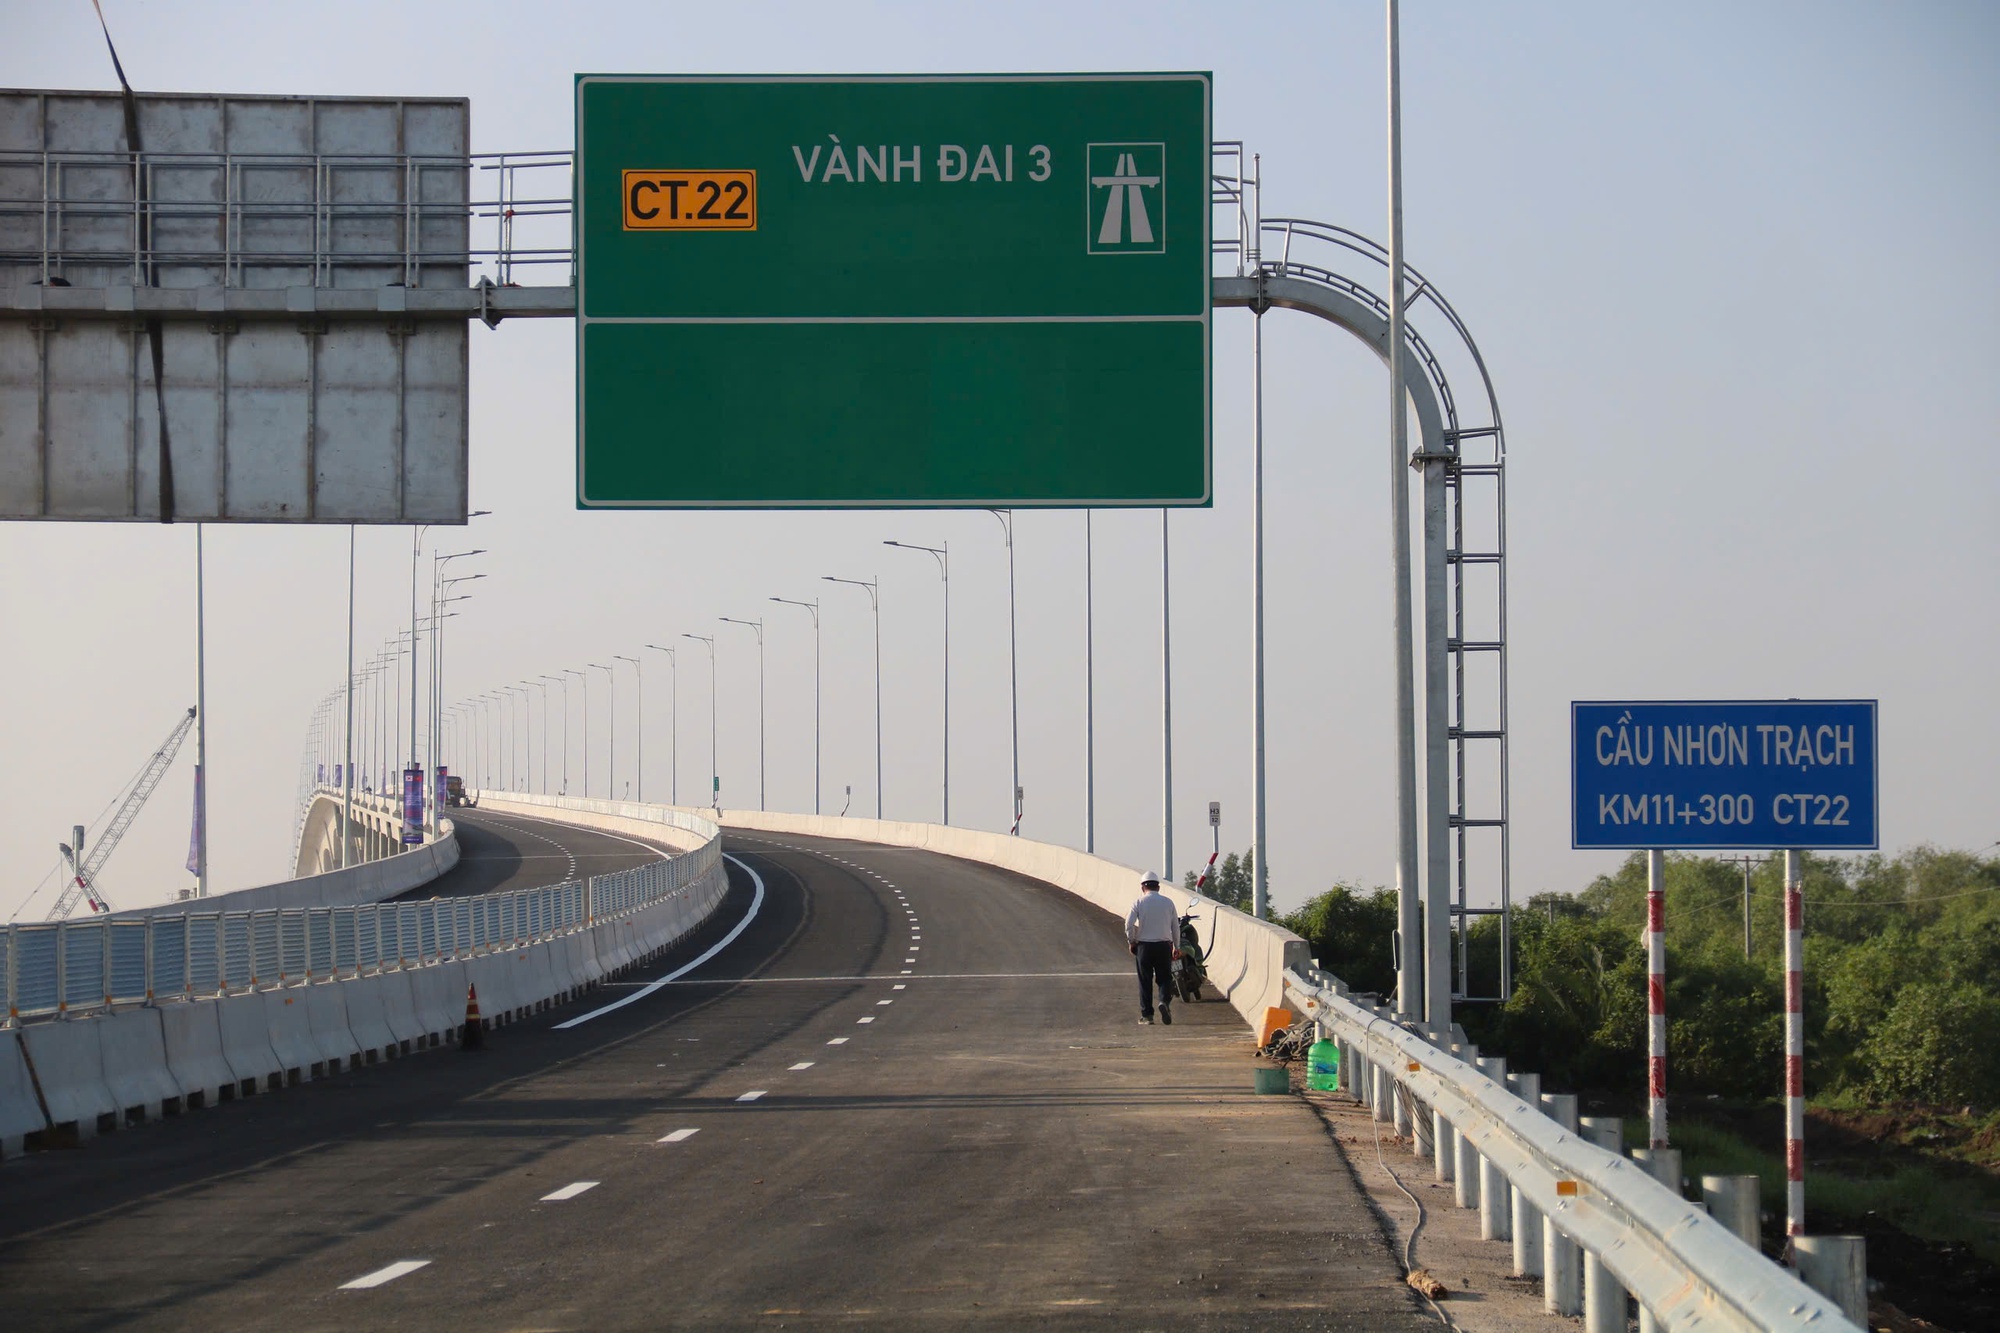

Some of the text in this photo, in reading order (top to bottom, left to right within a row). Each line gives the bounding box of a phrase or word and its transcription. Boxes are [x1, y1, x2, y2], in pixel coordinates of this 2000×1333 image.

[792, 134, 1052, 183] VÀNH ĐAI 3
[630, 180, 749, 220] CT.22
[1596, 711, 1854, 772] CẦU NHƠN TRẠCH
[1600, 794, 1850, 826] KM11+300 CT22
